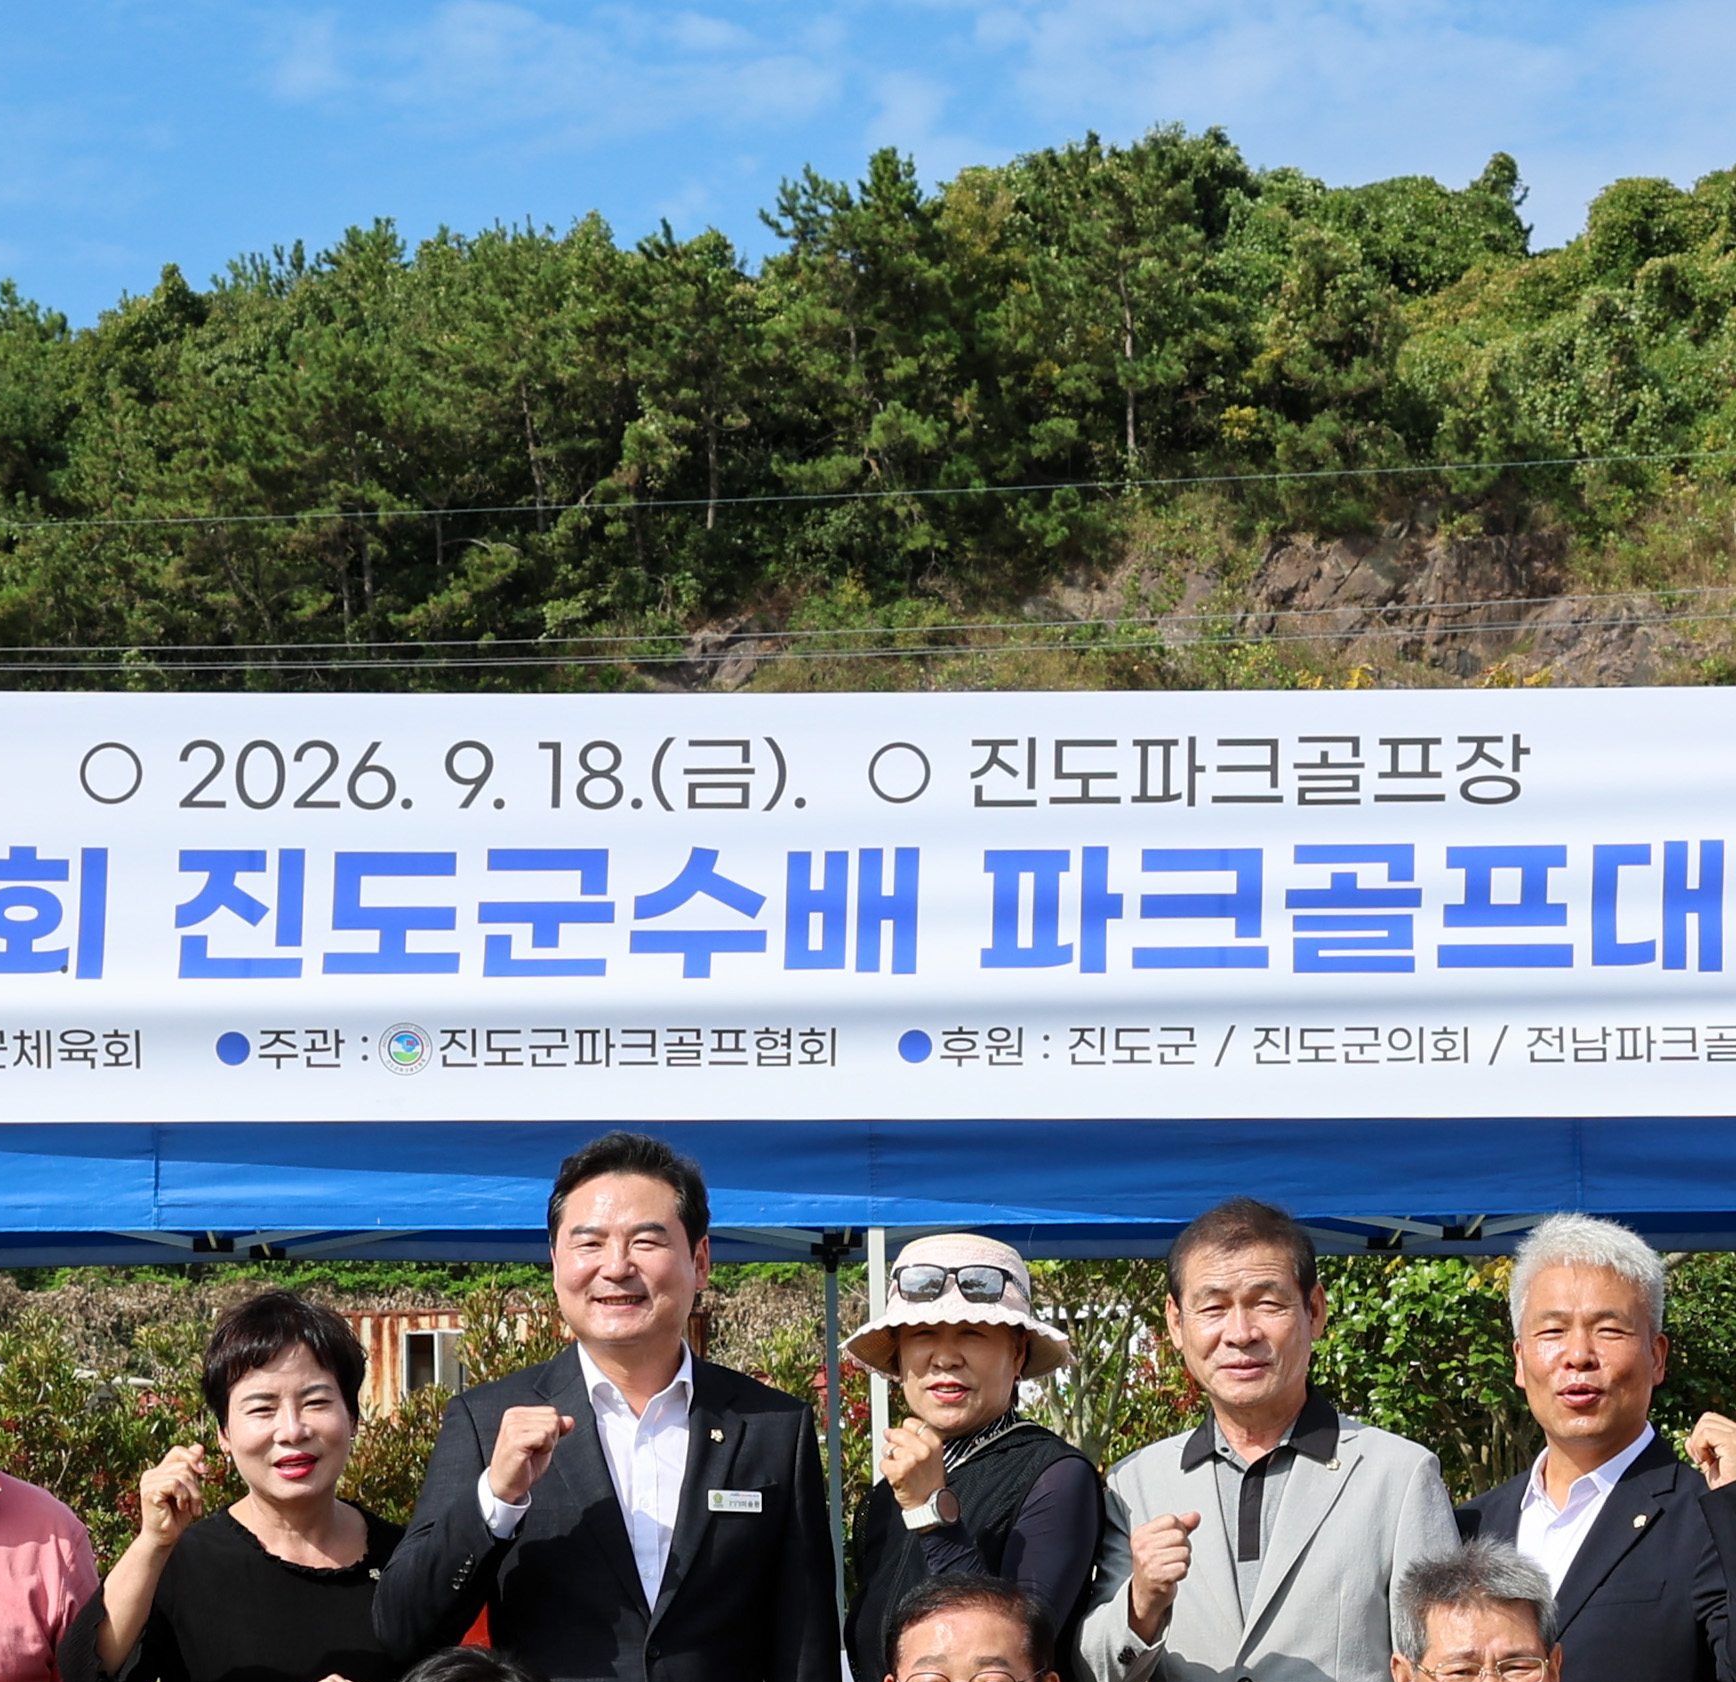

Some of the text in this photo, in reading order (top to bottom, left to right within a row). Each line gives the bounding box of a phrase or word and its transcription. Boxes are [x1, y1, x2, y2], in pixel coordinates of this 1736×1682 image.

[178, 738, 414, 811] 2026.
[444, 739, 506, 811] 9.
[969, 732, 1532, 809] 진도파크골프장
[174, 846, 921, 980] 진도군수배
[257, 1027, 347, 1071] 주관
[438, 1025, 838, 1069] 진도군파크골프협회
[939, 1025, 1024, 1068] 후원
[1068, 1025, 1198, 1066] 진도군
[1253, 1025, 1470, 1065] 진도군의회
